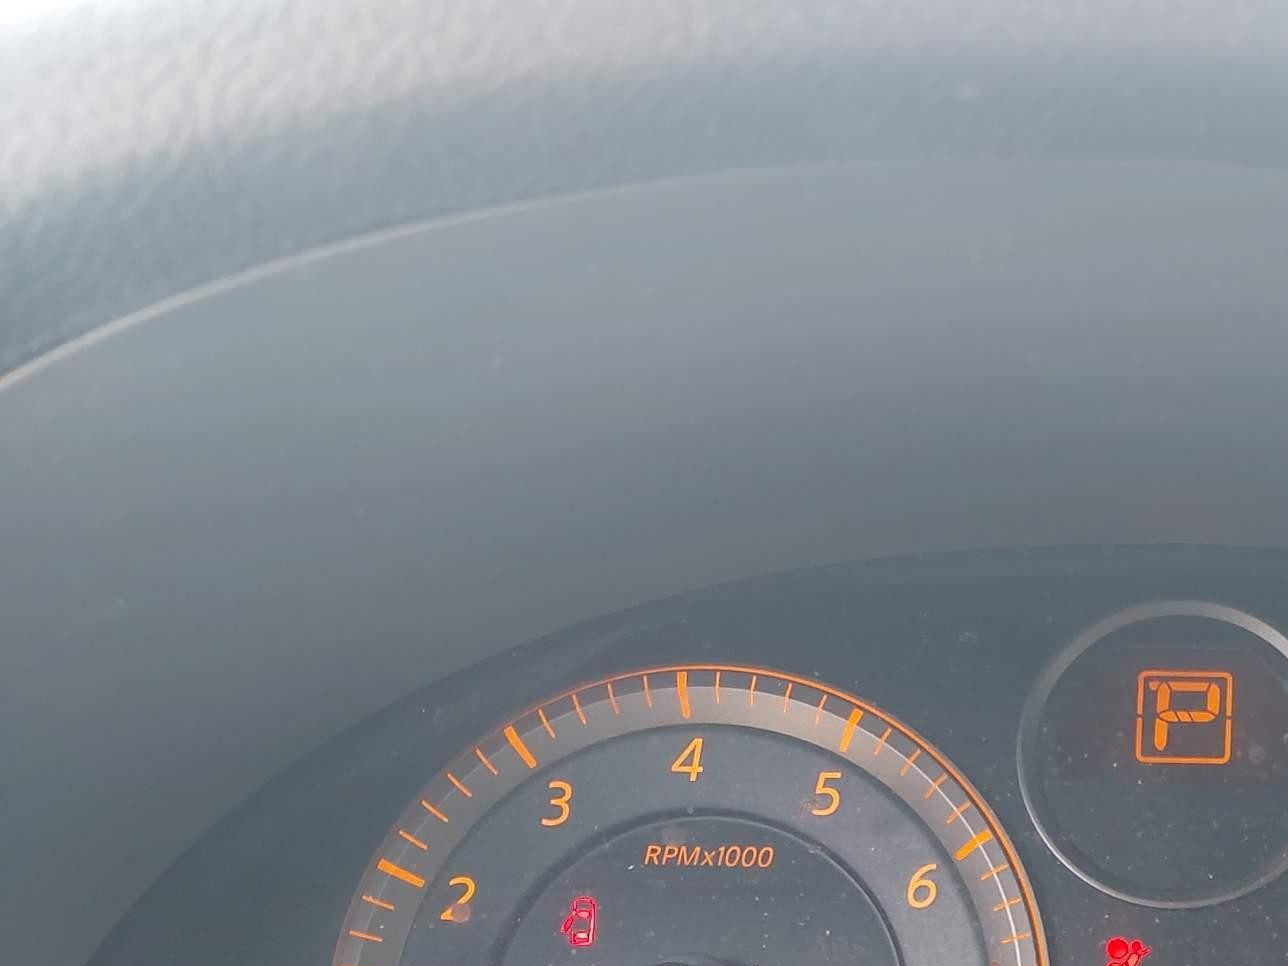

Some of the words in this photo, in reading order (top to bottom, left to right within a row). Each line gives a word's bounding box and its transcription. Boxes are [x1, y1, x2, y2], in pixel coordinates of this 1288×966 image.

[1150, 681, 1220, 752] P
[671, 737, 703, 781] 4
[541, 780, 574, 827] 3
[811, 770, 842, 817] 5
[643, 844, 775, 869] RPMx1000
[440, 876, 476, 922] 2
[906, 863, 938, 910] 6
